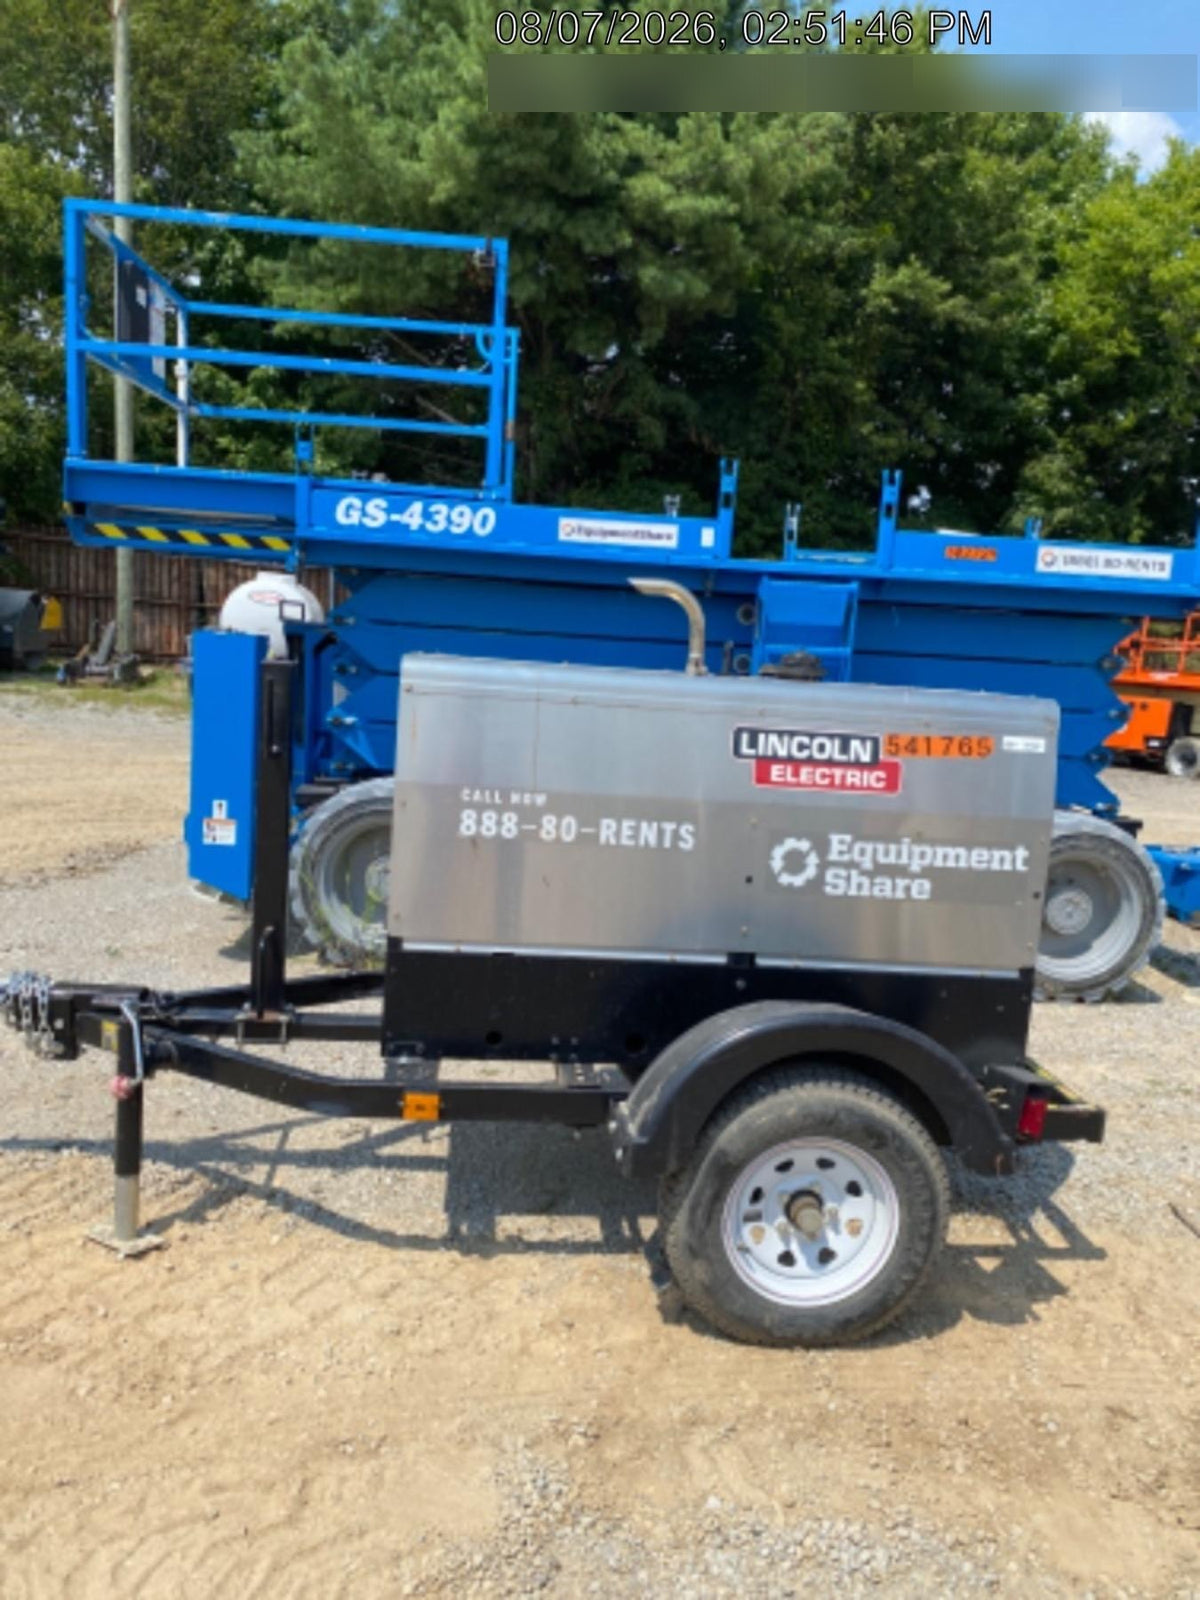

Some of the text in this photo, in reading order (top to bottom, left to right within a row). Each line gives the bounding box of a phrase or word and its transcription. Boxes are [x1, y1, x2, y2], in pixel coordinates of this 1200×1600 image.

[335, 496, 496, 536] GS-4390
[739, 731, 873, 763] LINCOLN
[886, 734, 992, 758] 541765
[770, 764, 886, 788] ELECTRIC
[461, 786, 547, 806] CALL NOW
[458, 808, 696, 852] 888-80-RENTS
[827, 833, 1029, 872] Equipment
[823, 867, 931, 900] Share
